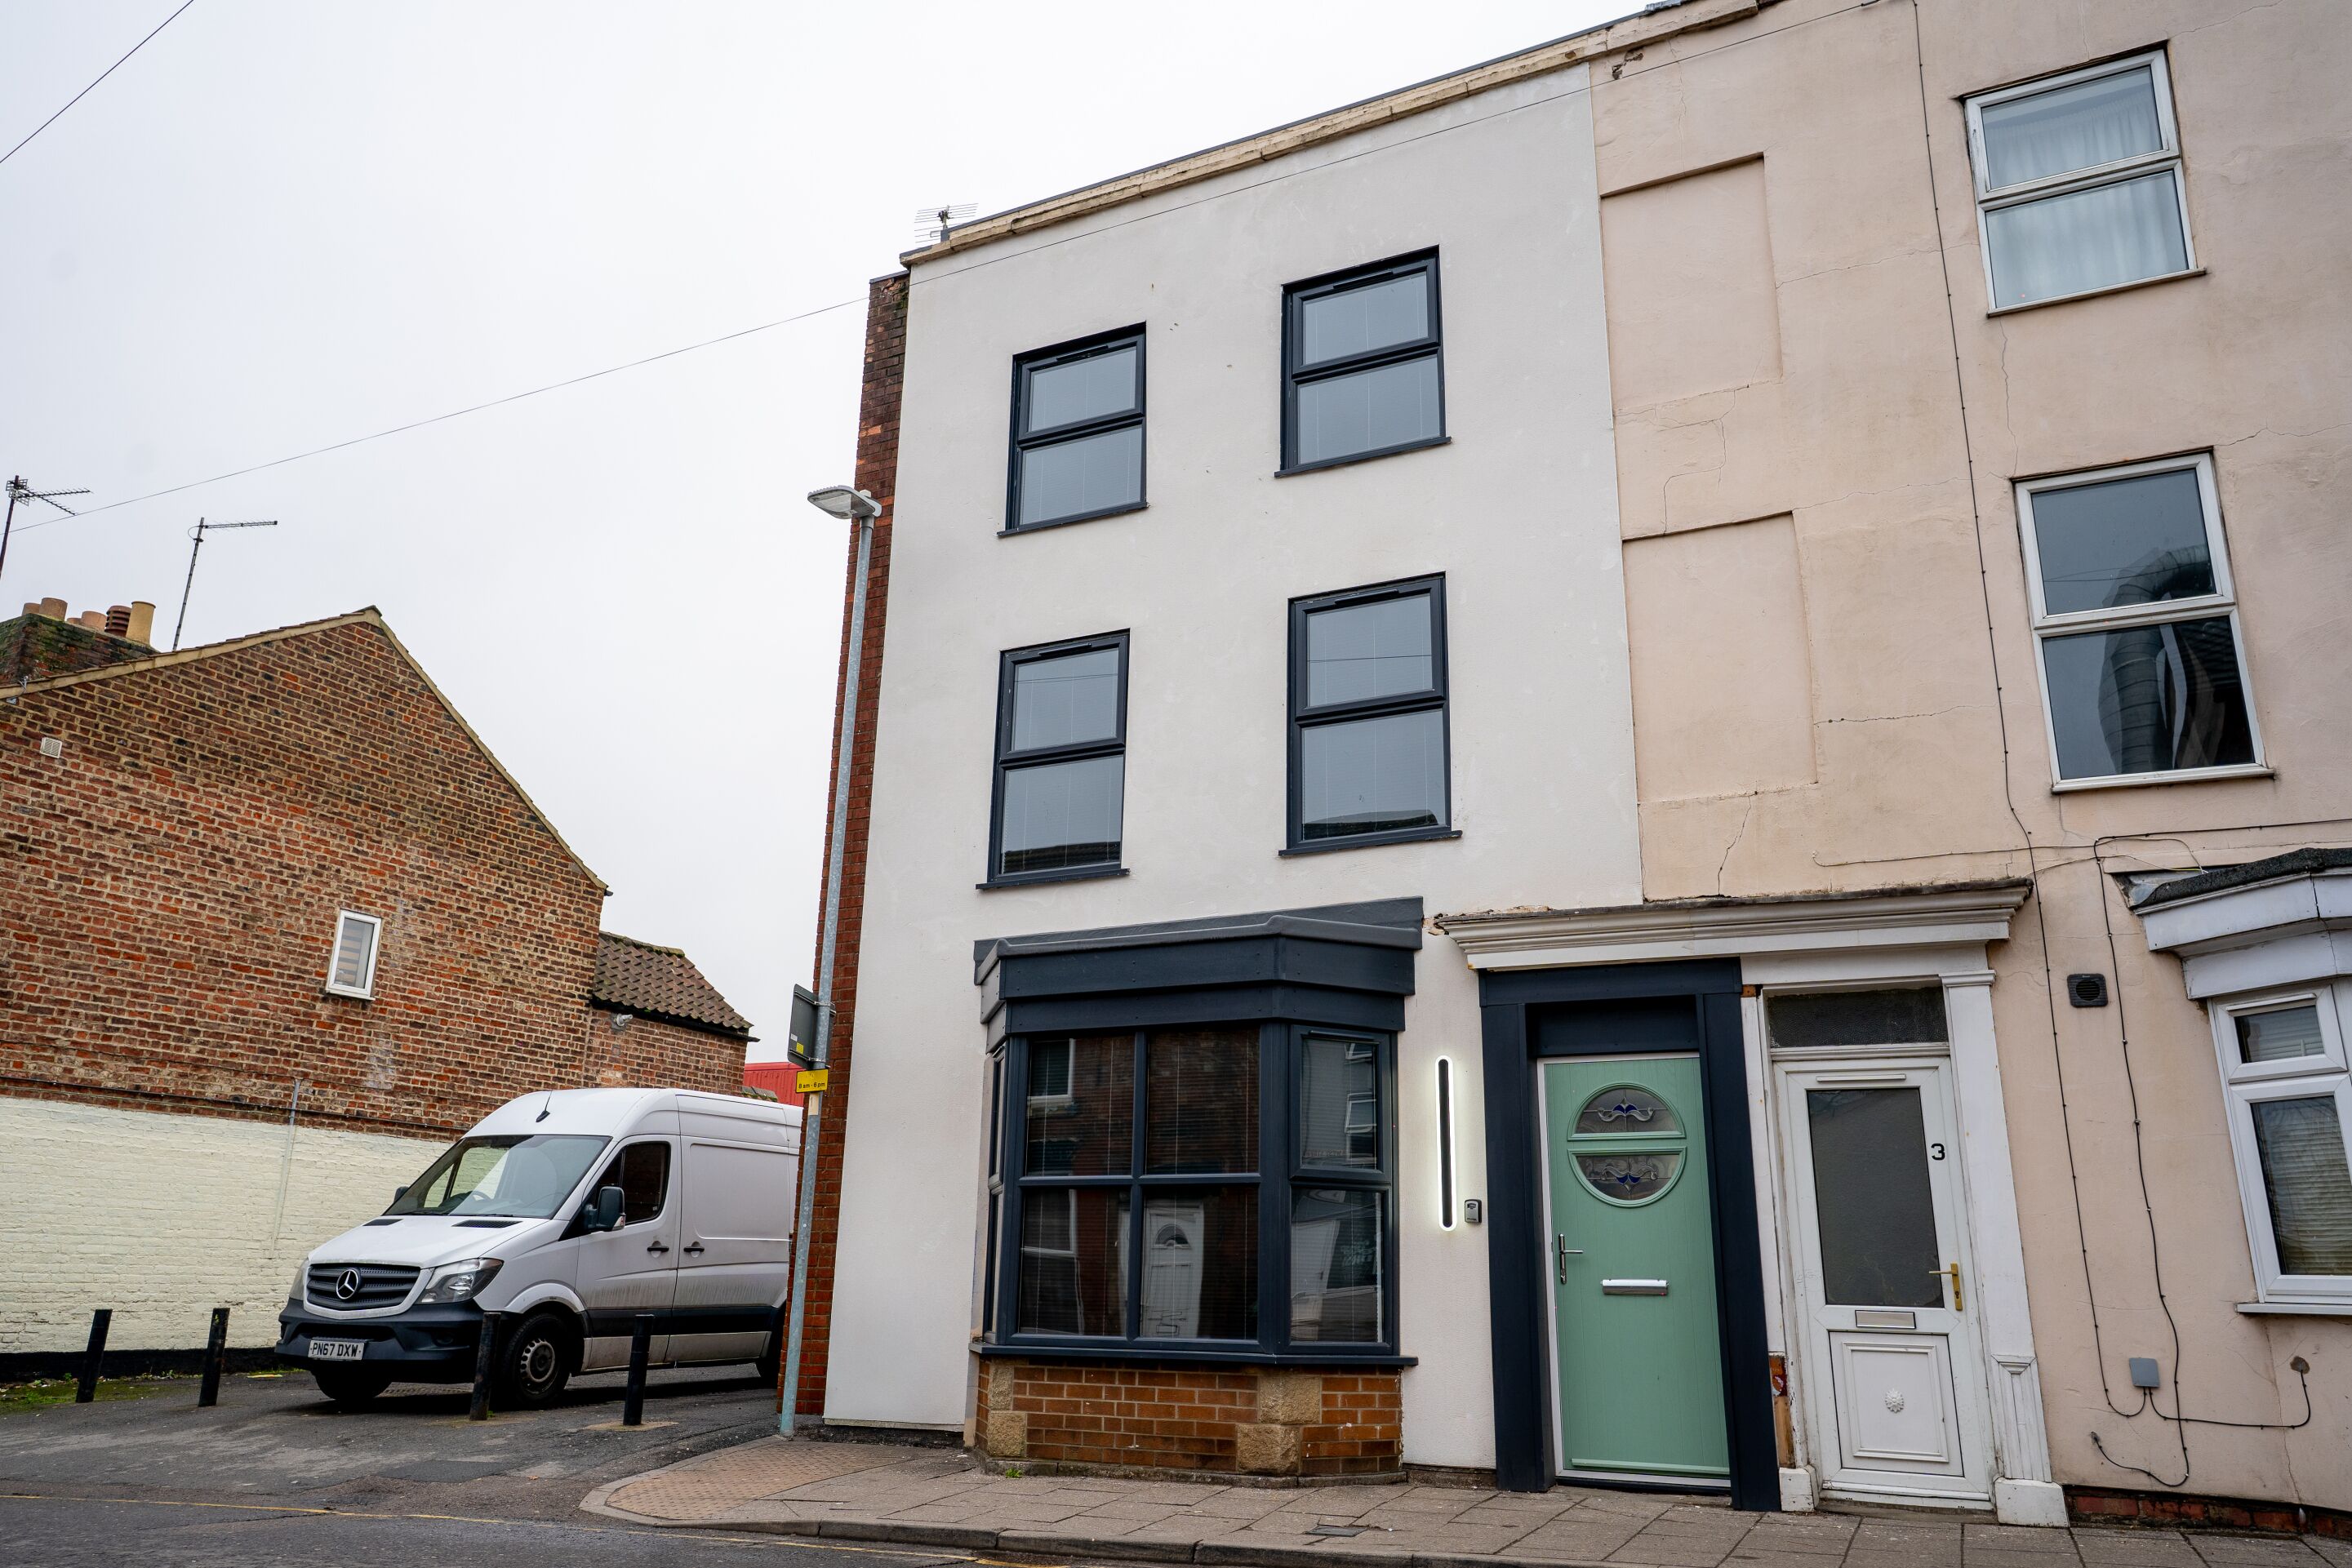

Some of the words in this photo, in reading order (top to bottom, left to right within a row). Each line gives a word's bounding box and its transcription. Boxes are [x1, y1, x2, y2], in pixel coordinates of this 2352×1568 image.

[1931, 1143, 1945, 1161] 3
[312, 1343, 336, 1356] PN67
[336, 1344, 358, 1357] DXW
